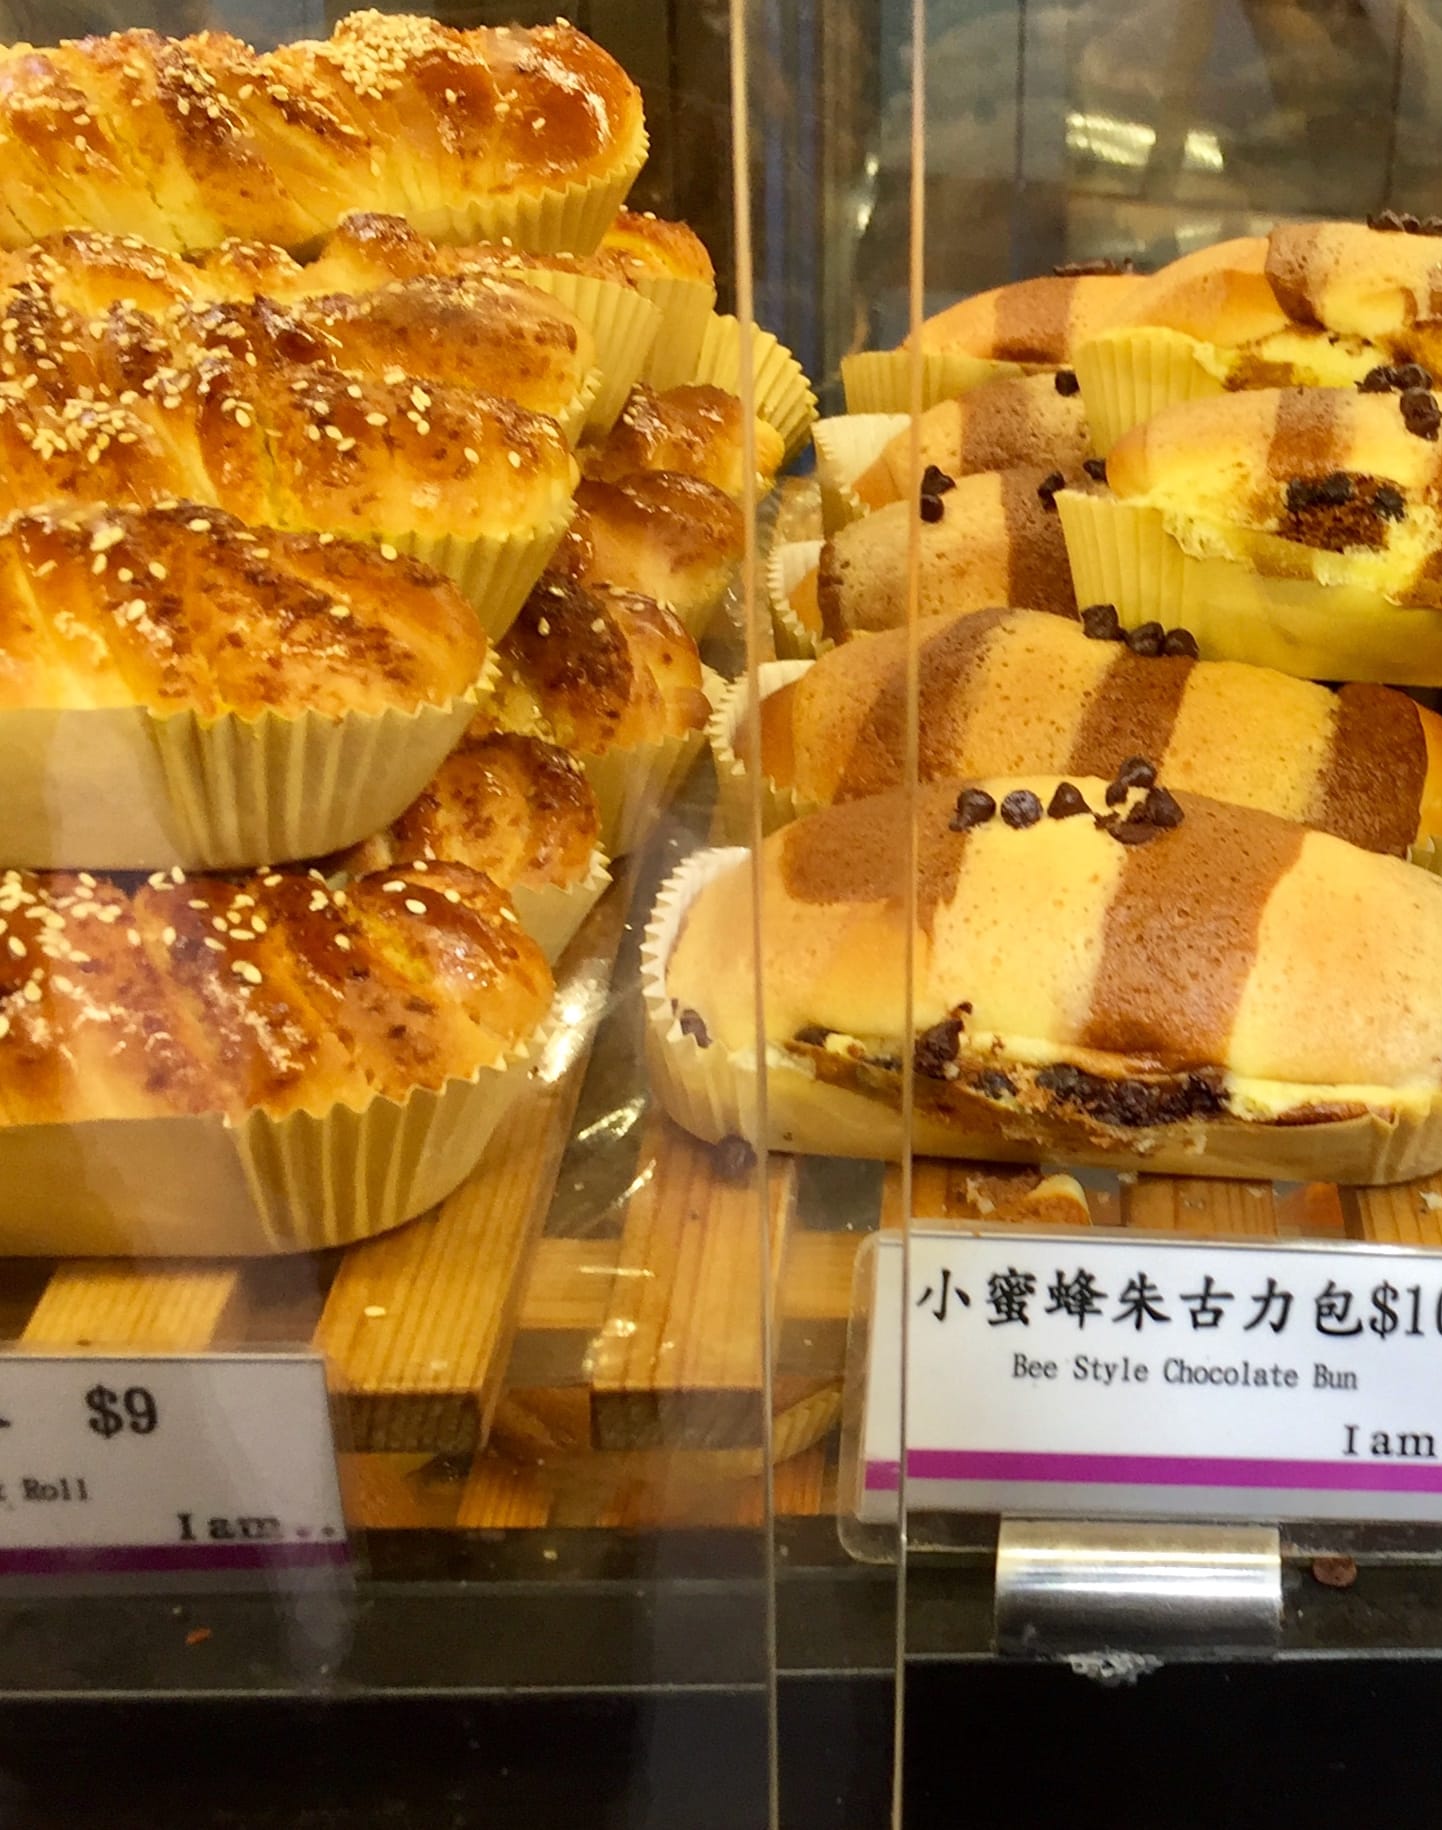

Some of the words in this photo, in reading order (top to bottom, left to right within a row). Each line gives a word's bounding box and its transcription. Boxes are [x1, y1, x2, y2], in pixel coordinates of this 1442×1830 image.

[1011, 1353, 1058, 1380] Bee
[1074, 1355, 1149, 1386] Style
[1163, 1359, 1299, 1389] Chocolate
[1312, 1363, 1358, 1391] Bun
[85, 1385, 157, 1439] $9
[1342, 1425, 1358, 1457] I
[23, 1477, 88, 1501] Roll
